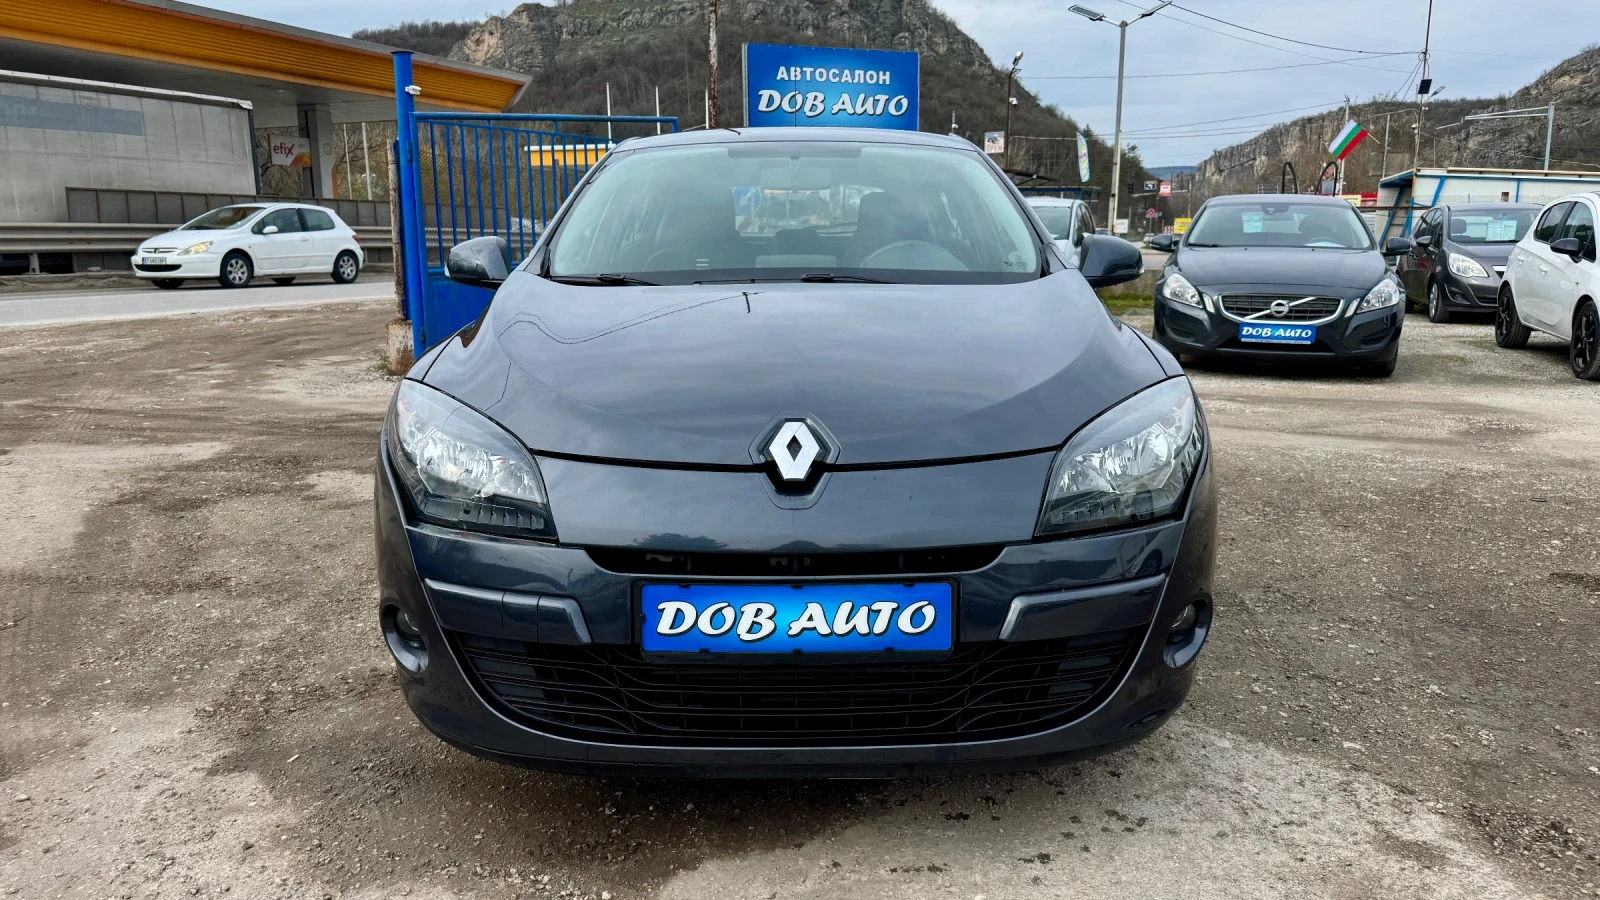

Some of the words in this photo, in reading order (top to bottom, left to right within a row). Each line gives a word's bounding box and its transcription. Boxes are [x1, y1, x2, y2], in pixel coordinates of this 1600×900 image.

[776, 66, 891, 85] АВТОСАЛОН
[758, 89, 826, 117] DOB
[831, 93, 909, 116] AUTO
[273, 142, 295, 158] efix
[1242, 326, 1272, 338] DOB
[1274, 328, 1312, 338] AUTO
[657, 600, 777, 641] DOB
[787, 600, 936, 637] AUTO
